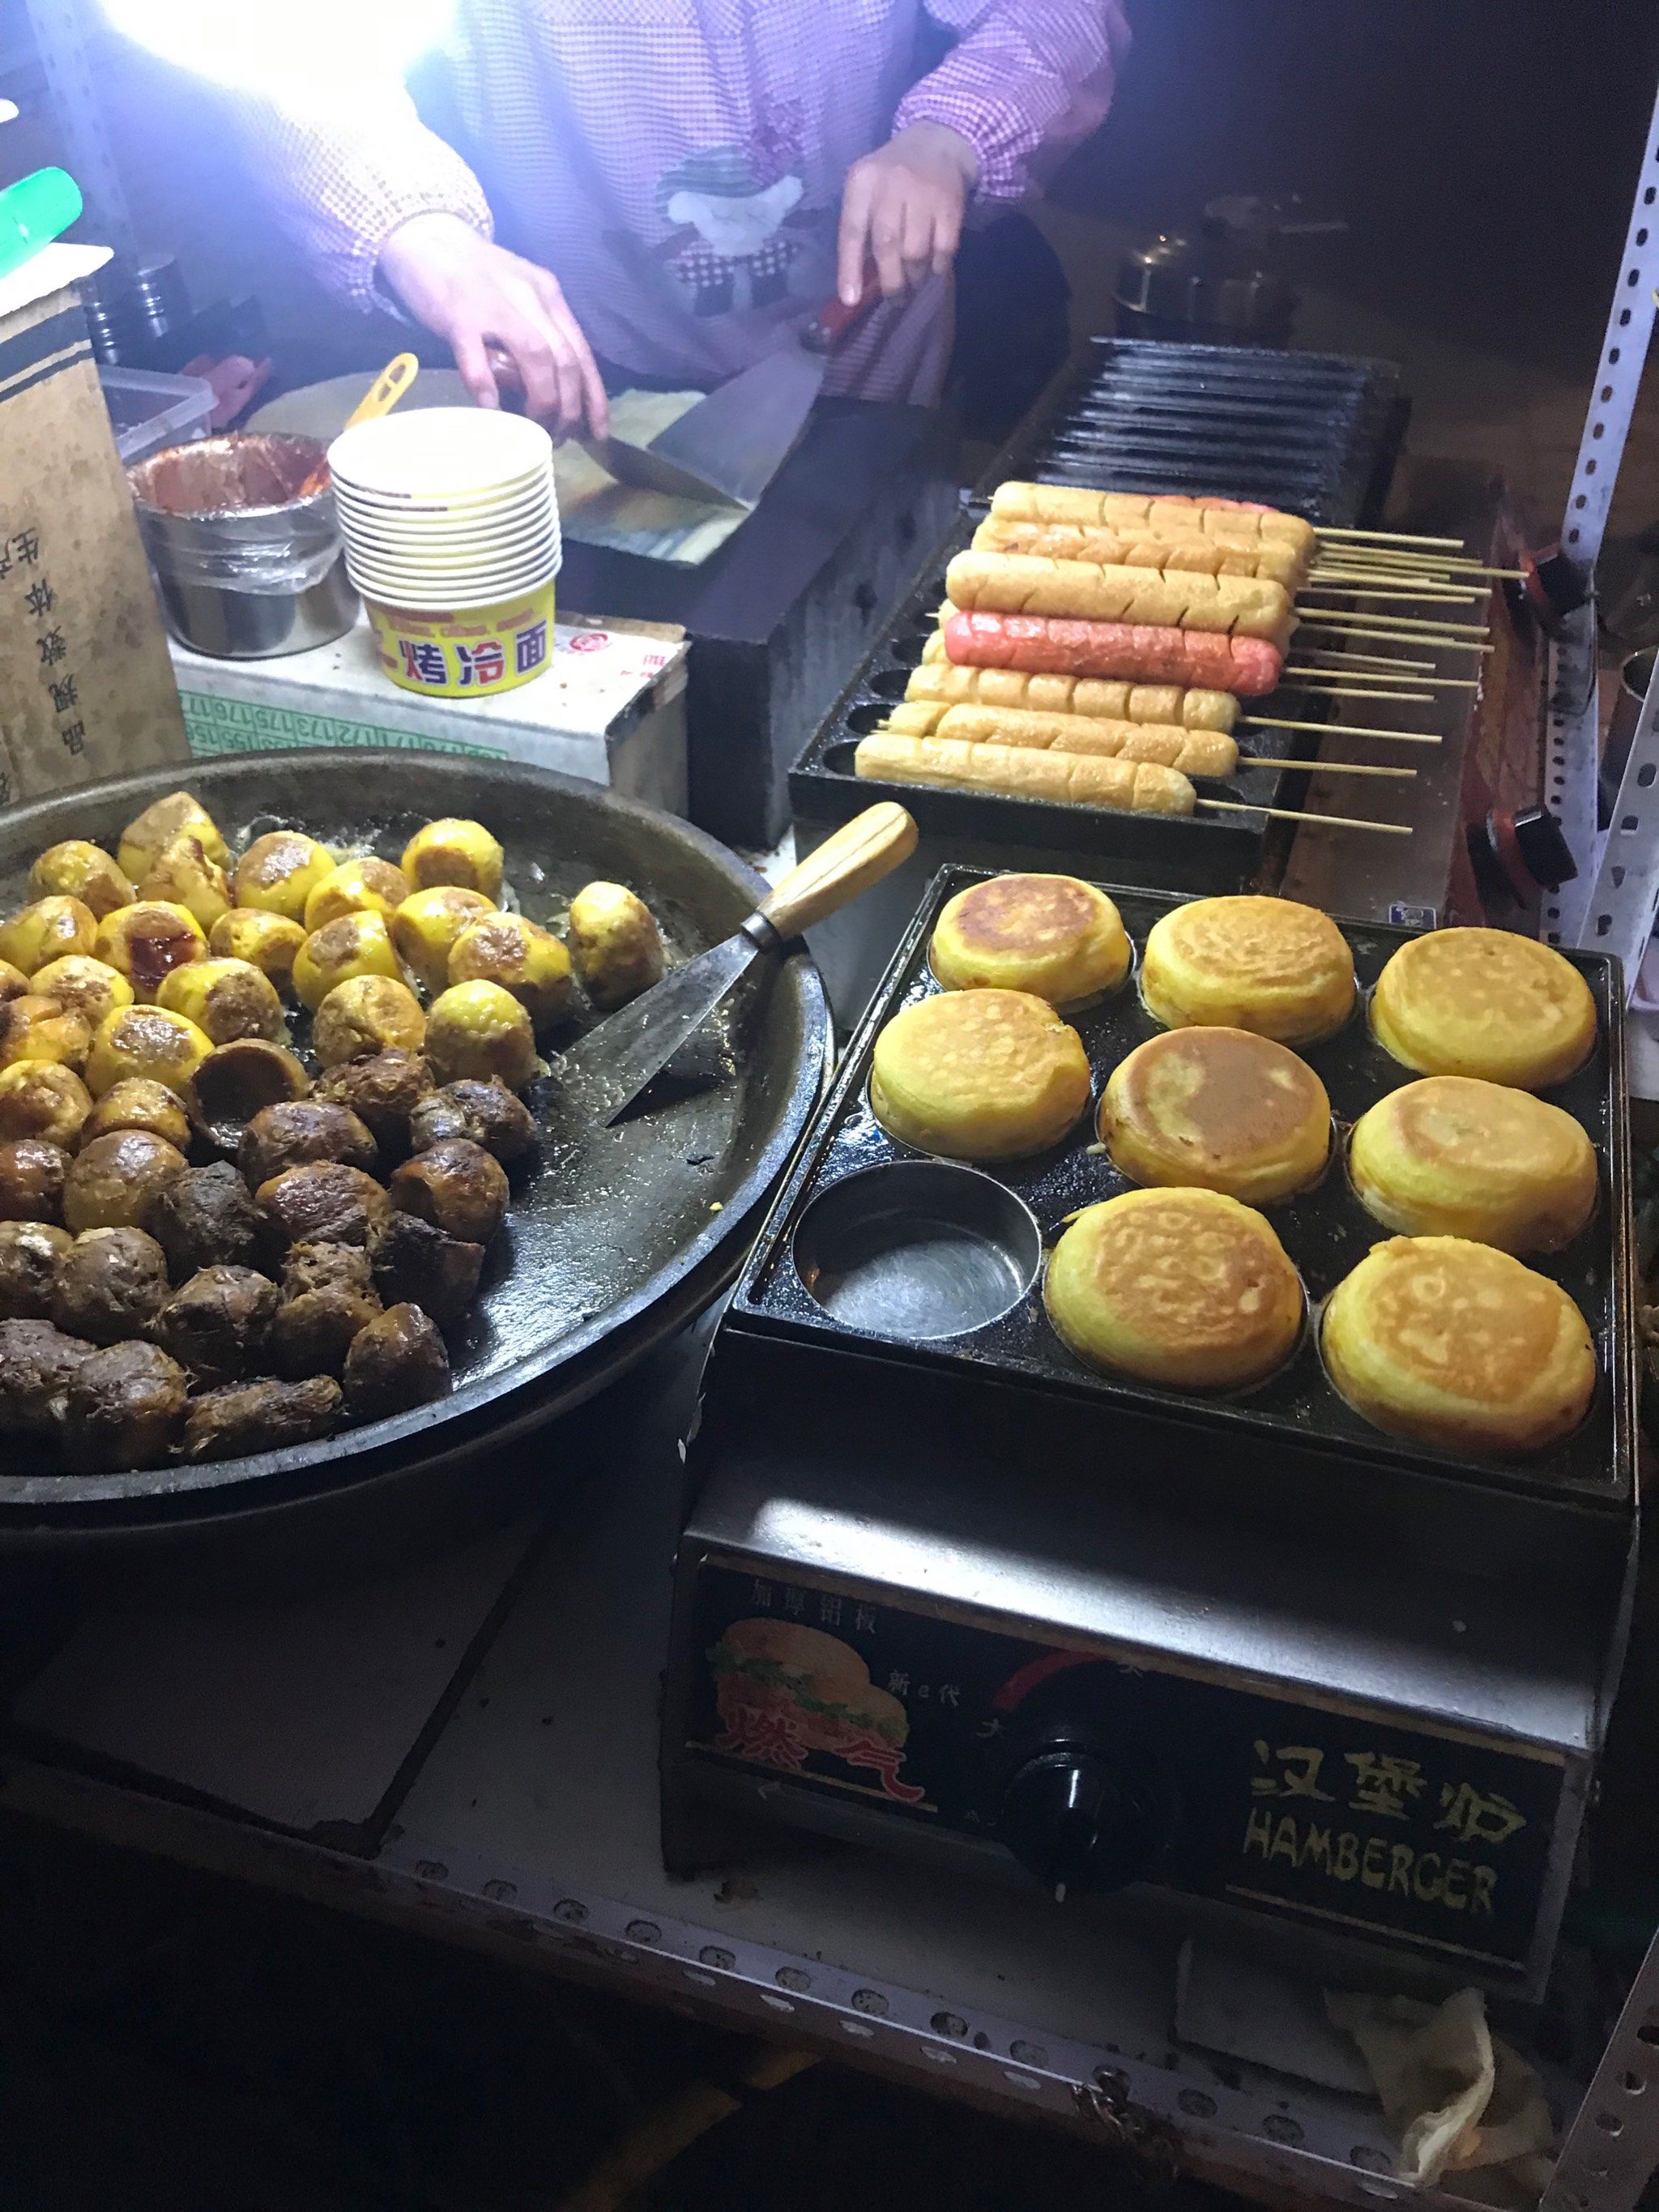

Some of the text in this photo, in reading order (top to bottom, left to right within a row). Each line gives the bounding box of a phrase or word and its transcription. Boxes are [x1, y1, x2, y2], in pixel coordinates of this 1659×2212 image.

[399, 620, 548, 686] 烤冷面
[214, 702, 252, 726] 176
[255, 710, 292, 732] 175
[296, 718, 333, 741] 173
[714, 1703, 926, 1803] 燃气
[1250, 1740, 1528, 1844] 汉堡炉
